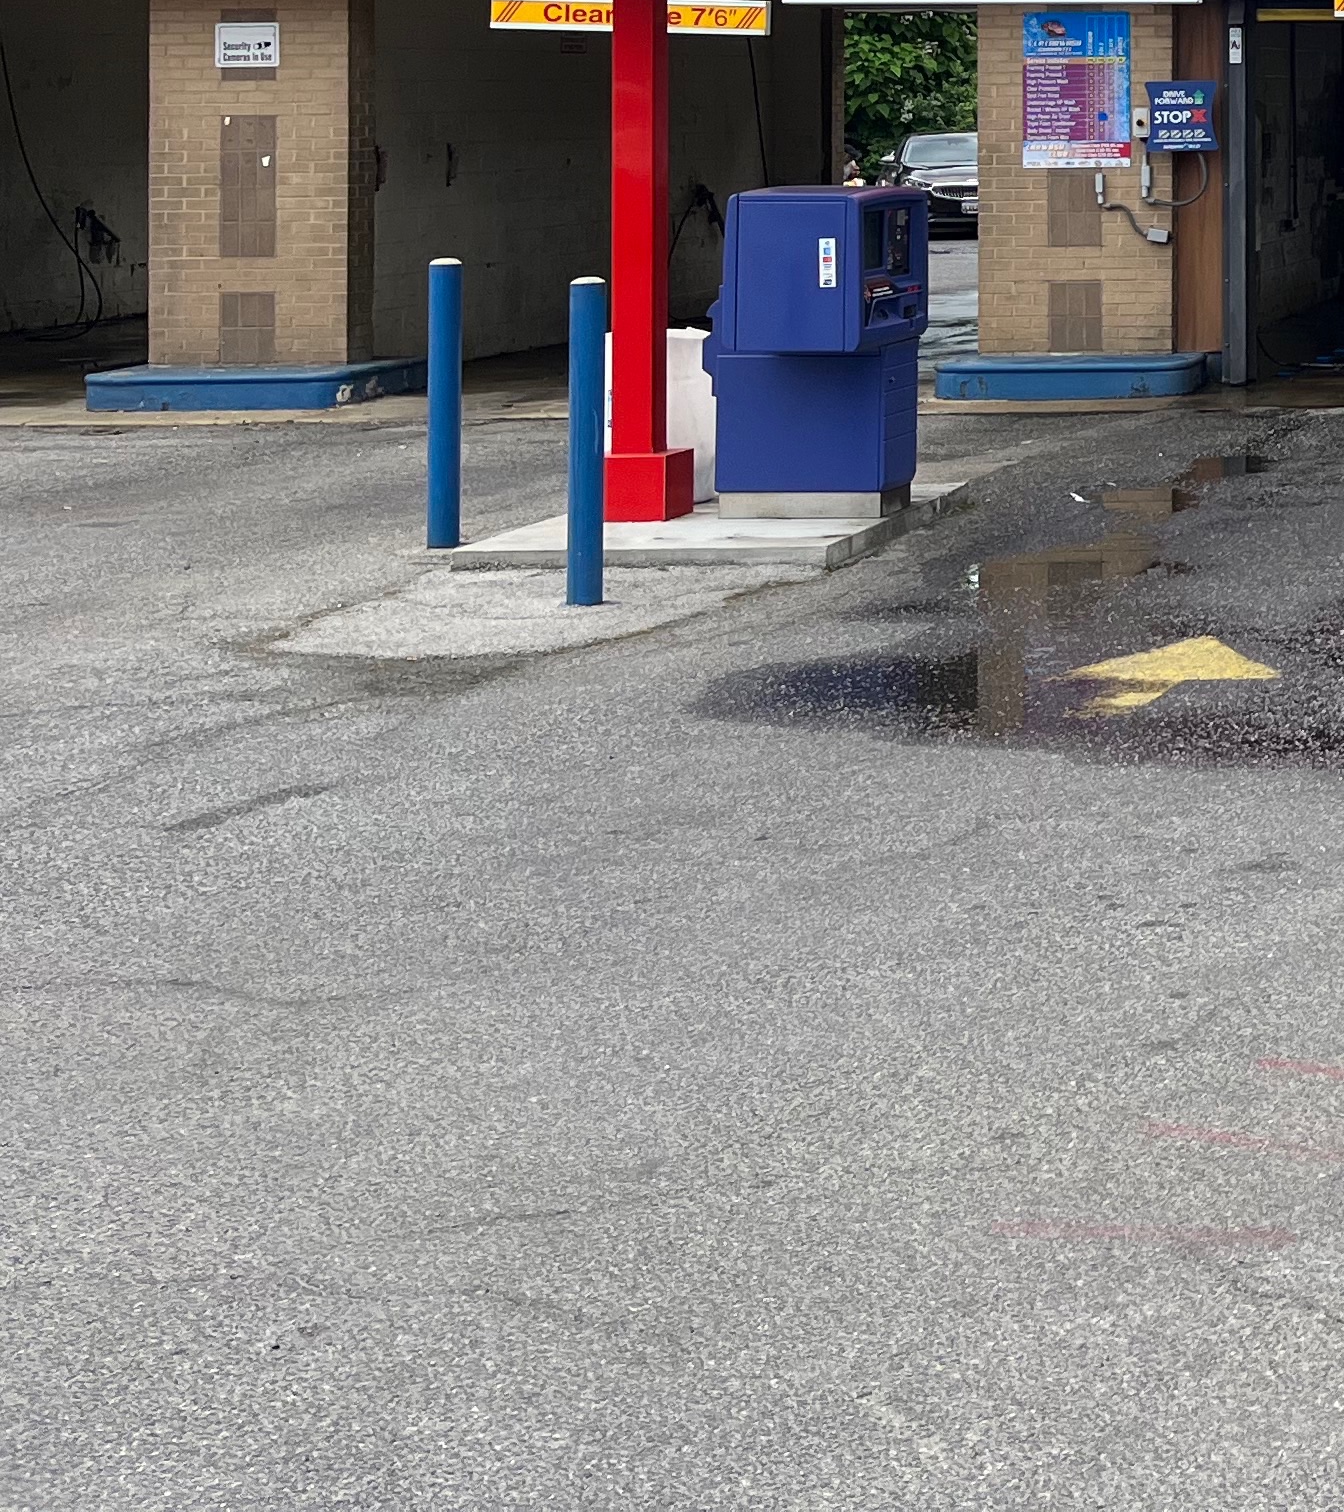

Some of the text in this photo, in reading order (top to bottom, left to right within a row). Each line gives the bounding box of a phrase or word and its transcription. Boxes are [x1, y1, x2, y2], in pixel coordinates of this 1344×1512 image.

[543, 2, 682, 25] Cleare
[223, 41, 251, 52] Security
[1163, 90, 1186, 98] DRIVE
[1154, 110, 1191, 124] STOP
